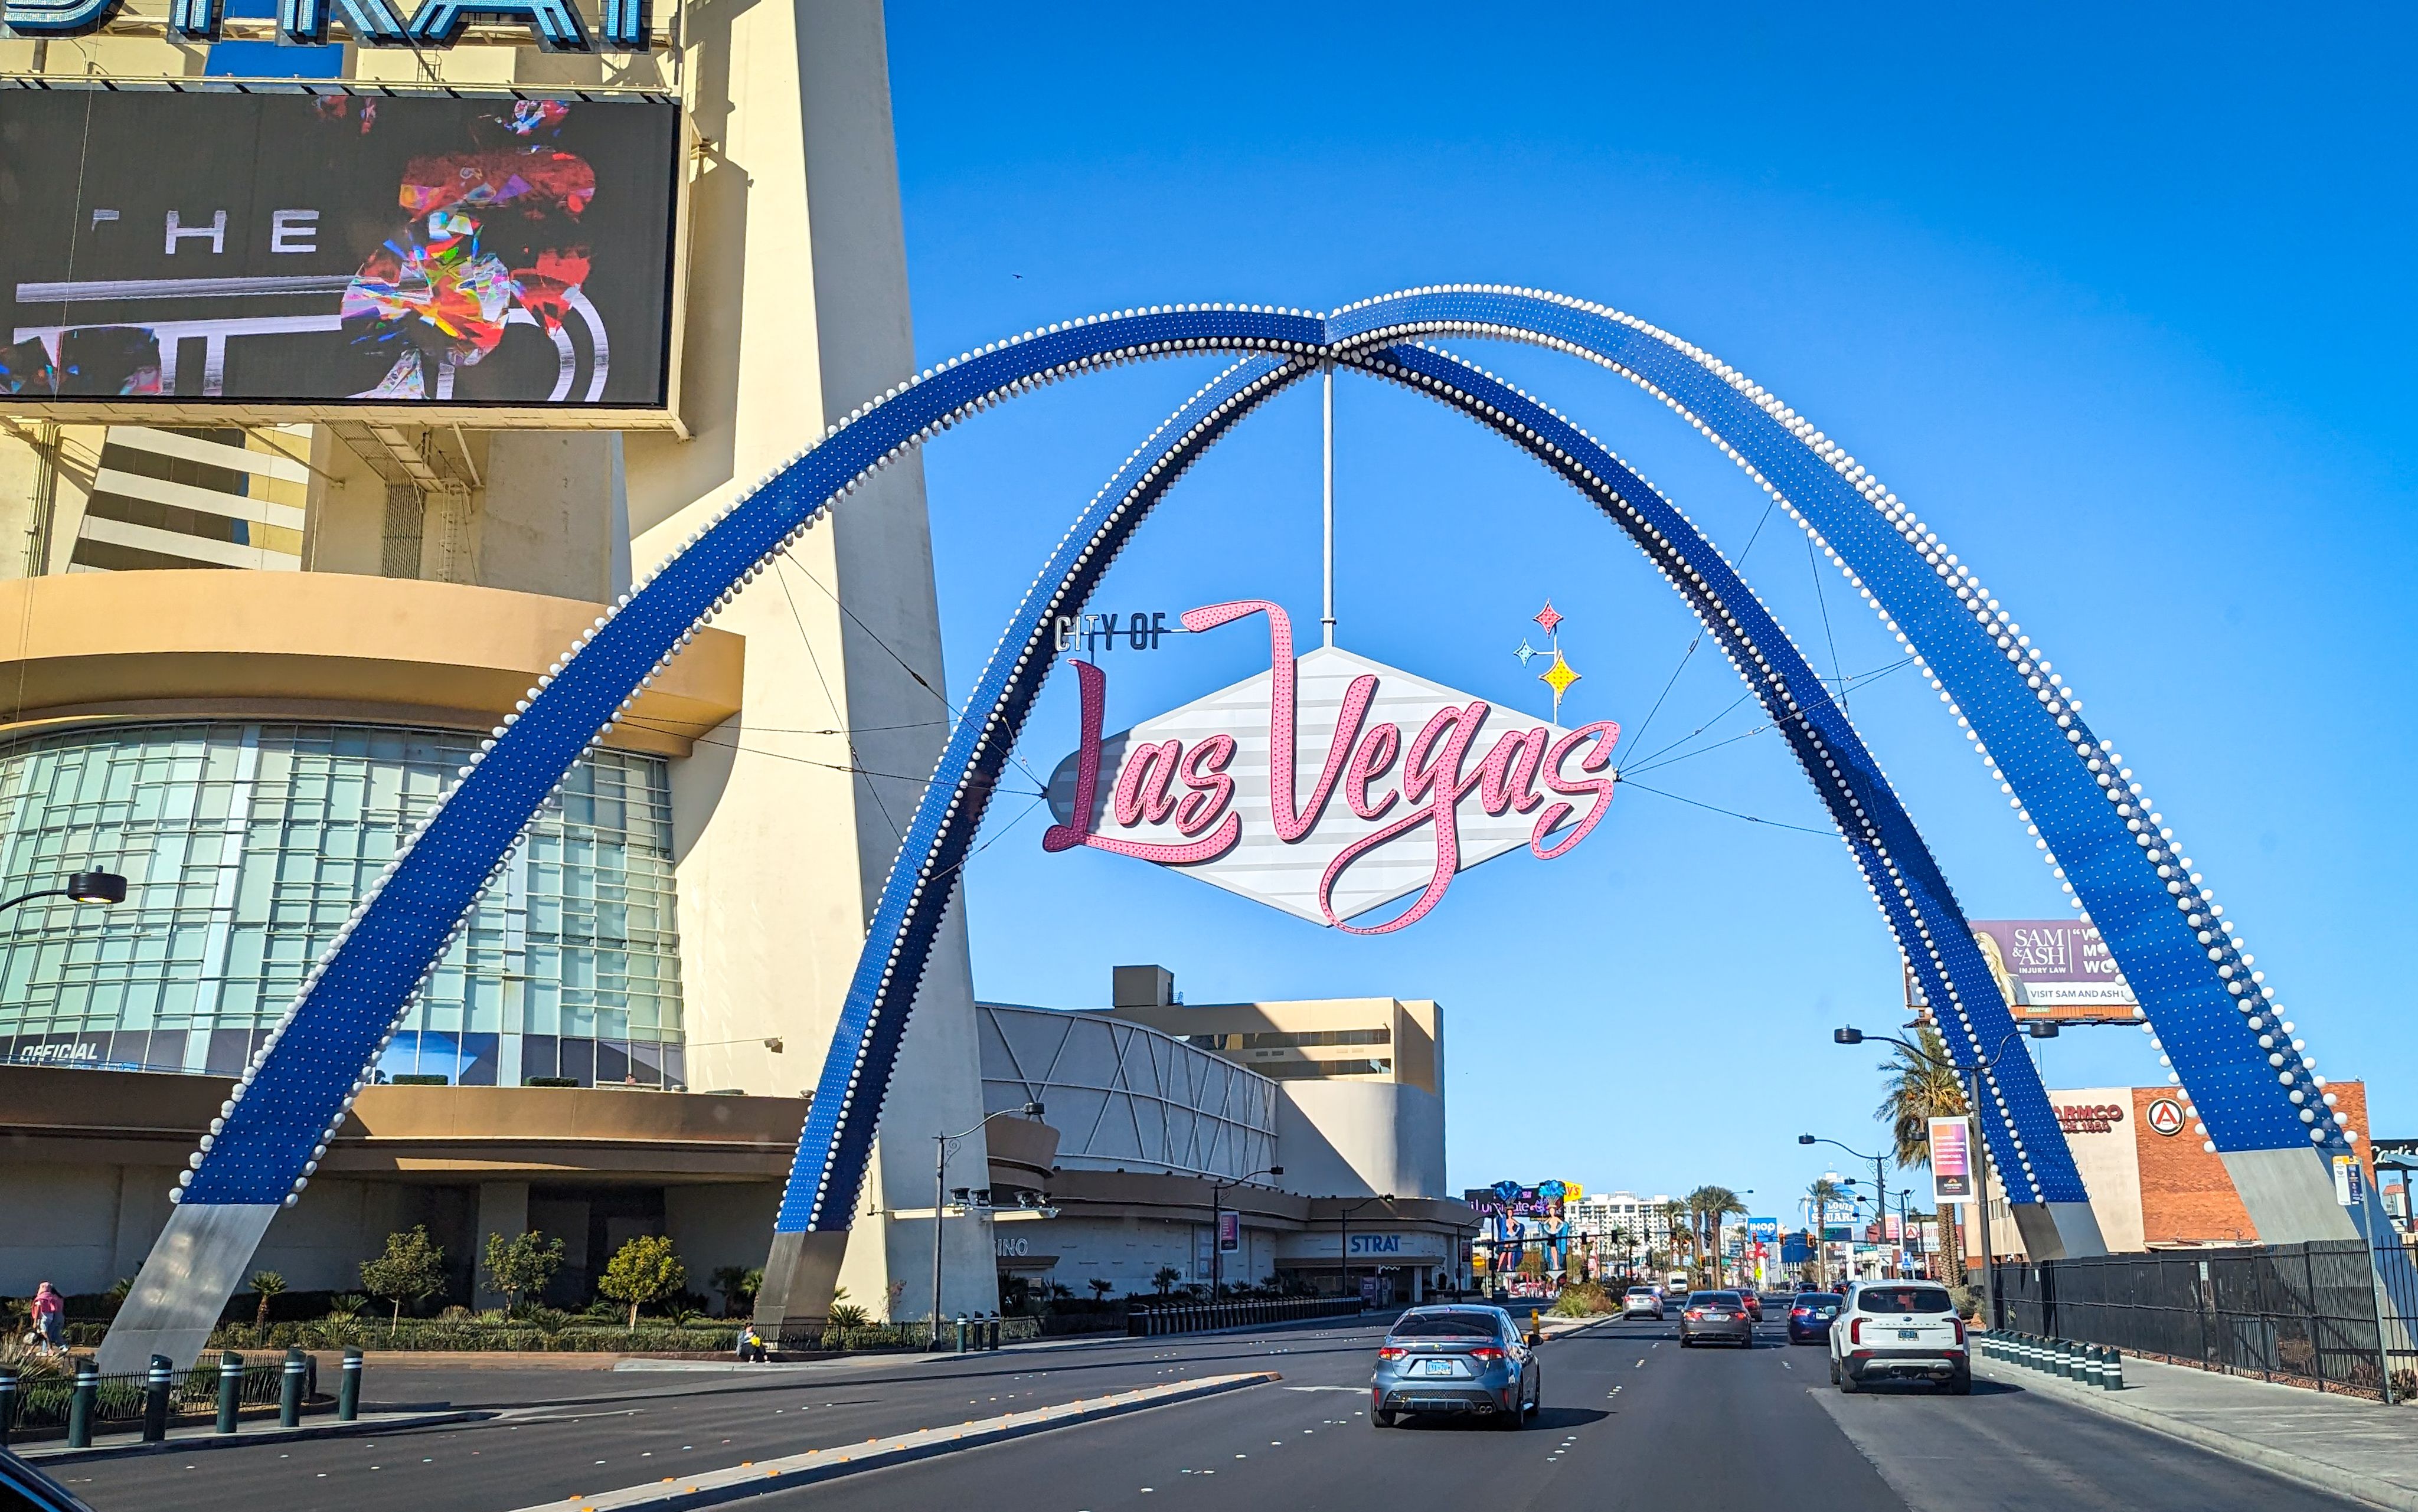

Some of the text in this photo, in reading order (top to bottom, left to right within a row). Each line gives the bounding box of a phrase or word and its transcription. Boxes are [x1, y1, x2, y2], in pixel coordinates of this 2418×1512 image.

[1054, 612, 1166, 652] CITY OF
[1043, 600, 1621, 935] Las Vegas
[2014, 928, 2064, 947] SAM
[2031, 990, 2053, 998] VISIT
[2055, 990, 2076, 998] SAM
[2077, 990, 2099, 998] AND
[19, 1042, 98, 1062] OFFICIAL
[2053, 1104, 2123, 1120] ARMCO
[1566, 1185, 1580, 1197] y's
[1827, 1202, 1855, 1212] LOUIS
[1749, 1222, 1776, 1233] IHOP
[995, 1238, 1028, 1256] INO
[1350, 1235, 1401, 1252] STRAT
